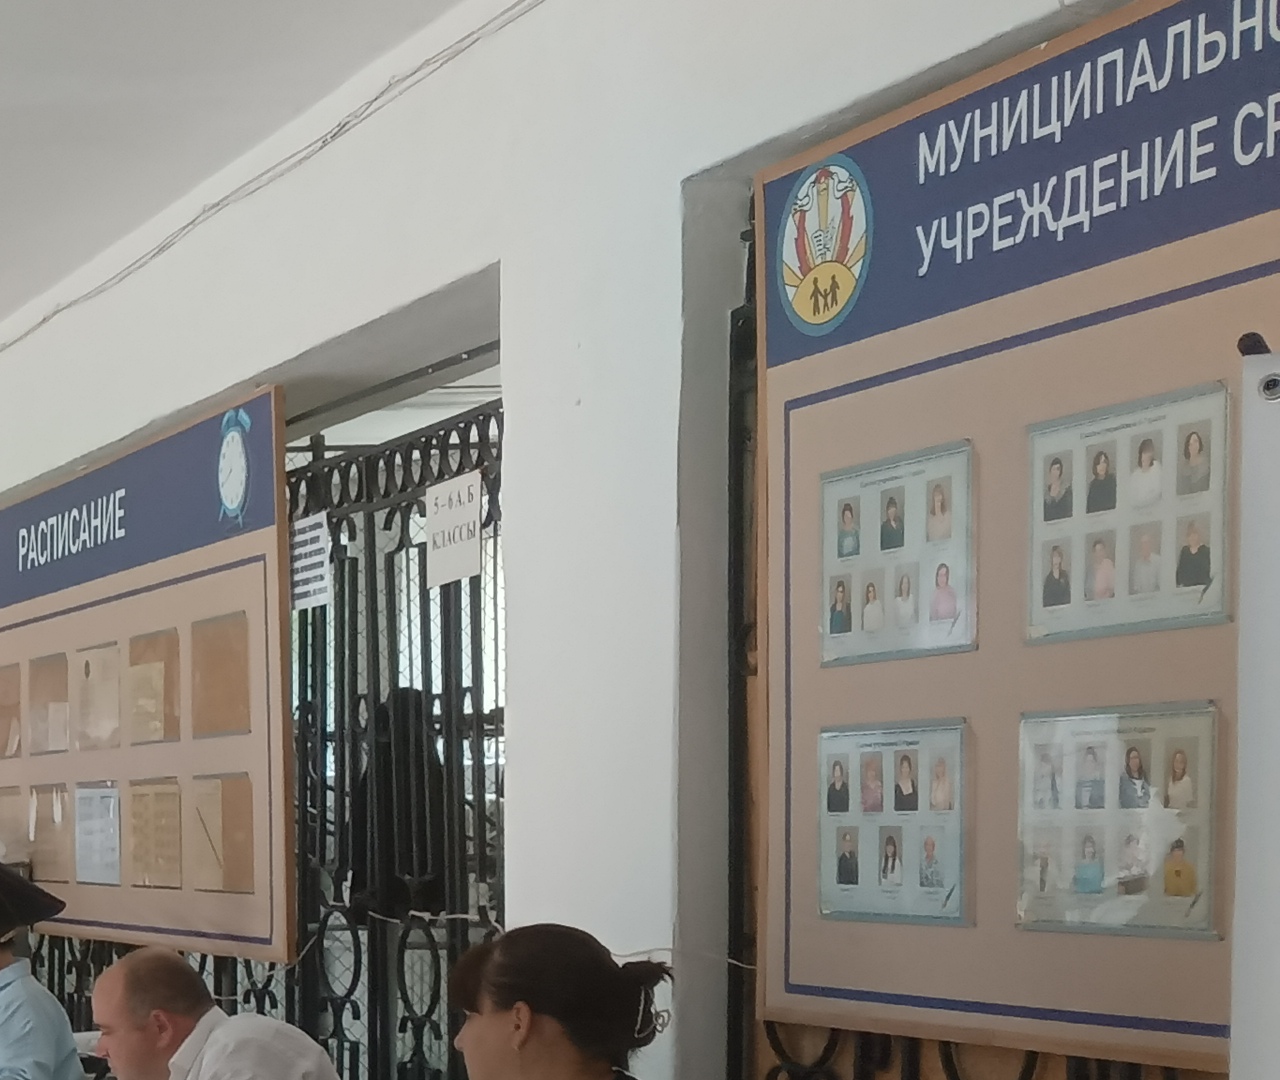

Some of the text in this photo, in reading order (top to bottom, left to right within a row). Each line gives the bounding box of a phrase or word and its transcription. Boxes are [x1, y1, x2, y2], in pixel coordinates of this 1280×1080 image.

[915, 116, 1218, 277] УЧРЕЖДЕНИЕ
[17, 487, 127, 573] РАСПИСАНИЕ
[432, 520, 476, 552] КЛАССЫ
